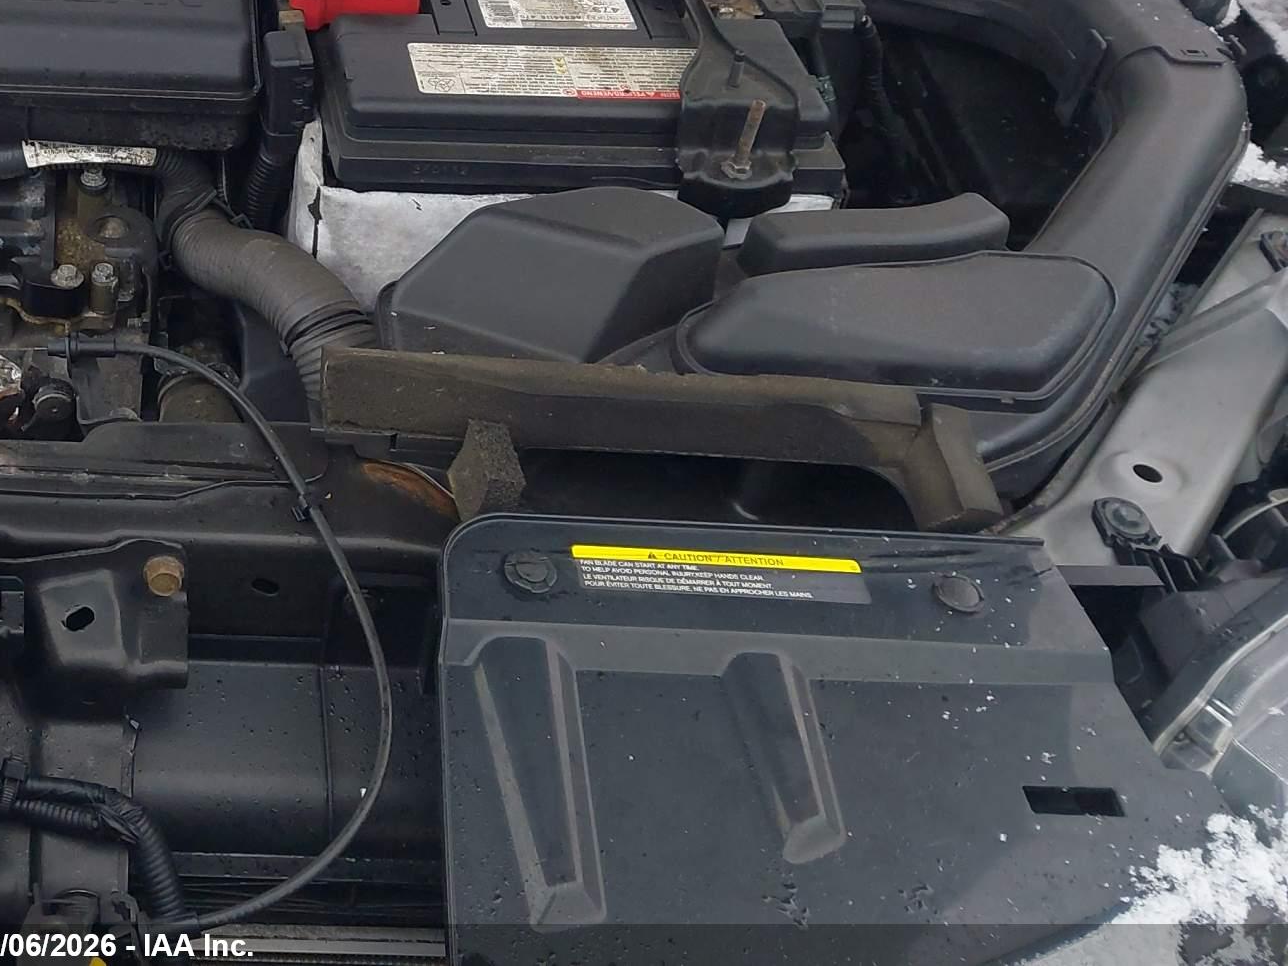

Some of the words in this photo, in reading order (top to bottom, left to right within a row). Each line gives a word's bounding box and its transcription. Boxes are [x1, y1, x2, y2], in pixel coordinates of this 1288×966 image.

[664, 552, 712, 562] CAUTION
[725, 555, 784, 566] ATTENTION
[634, 568, 671, 577] PERSONAL
[593, 575, 637, 583] VENTILATEUR
[638, 576, 664, 584] RISQUE
[677, 577, 714, 586] DÉMARRER
[731, 588, 774, 596] APPROCHER
